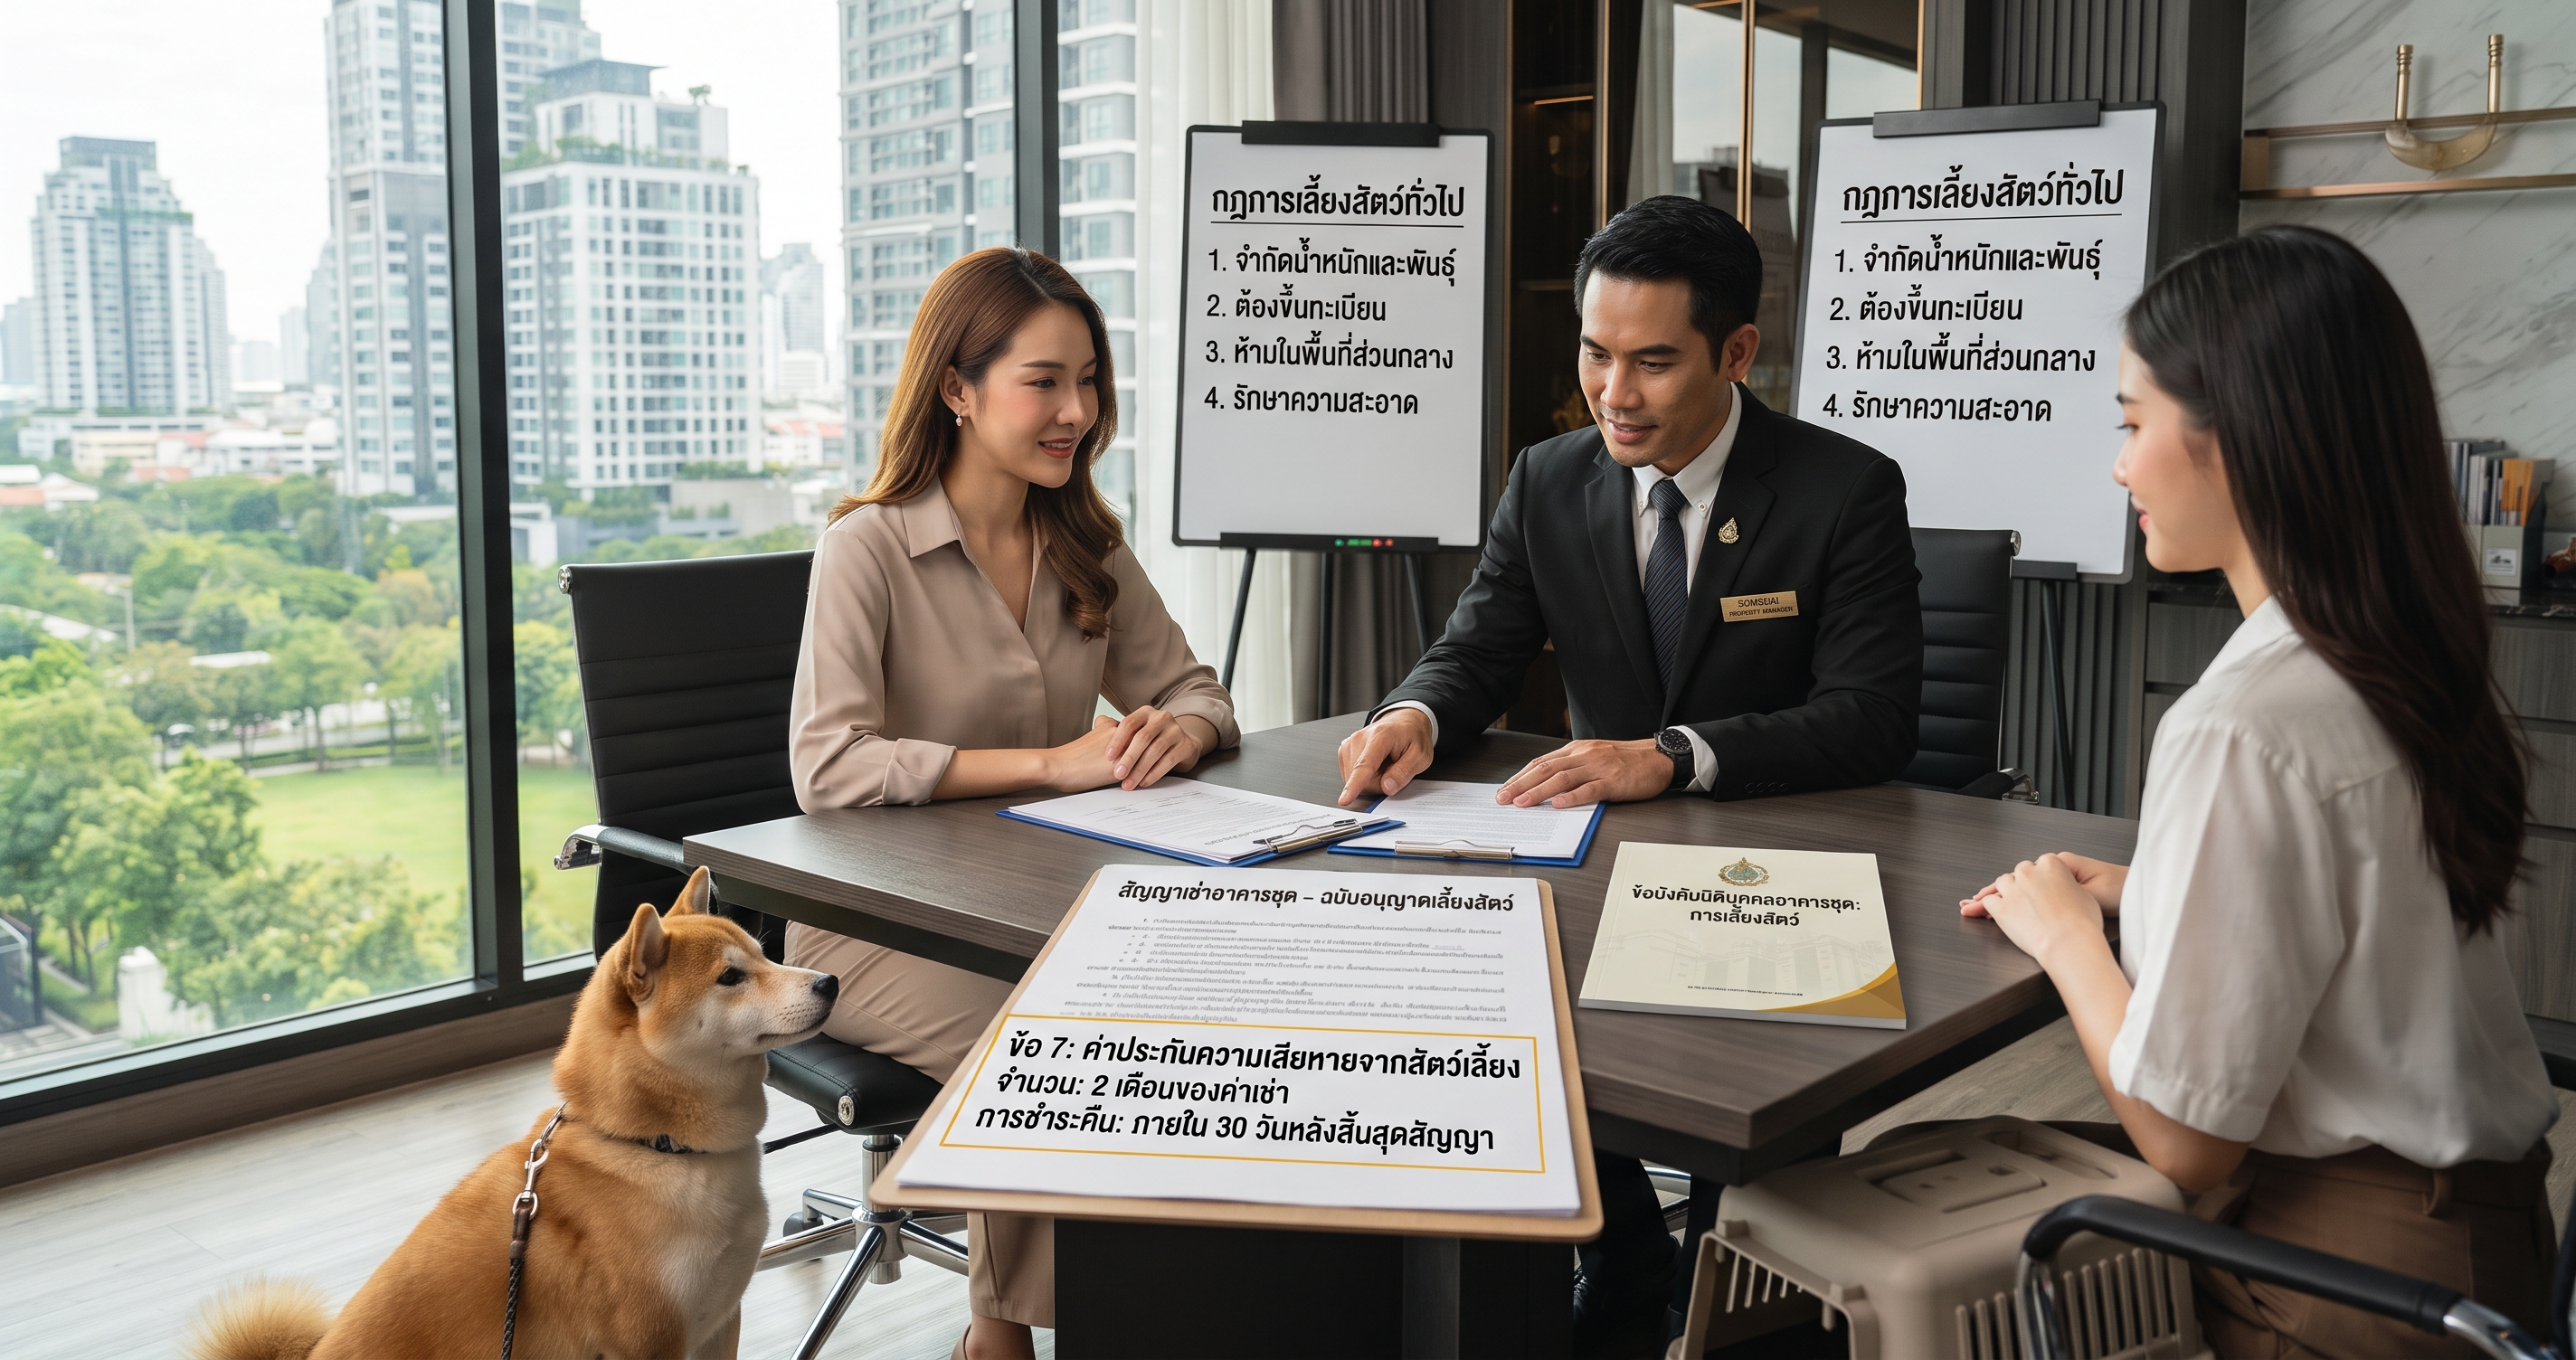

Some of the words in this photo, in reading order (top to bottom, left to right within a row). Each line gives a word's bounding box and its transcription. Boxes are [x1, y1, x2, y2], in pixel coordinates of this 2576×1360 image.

[1208, 248, 1226, 271] 1.
[1236, 237, 1457, 288] จำกัดน้ำหนักและพันธุ์
[1834, 249, 1854, 273] 1.
[1863, 233, 2104, 280] จำกัดน้ำหนักและพันธุ์
[1207, 294, 1226, 317] 2.
[1236, 283, 1386, 322] ต้องขึ้นทะเบียน
[1829, 297, 1851, 321] 2.
[1860, 283, 2023, 321] ต้องขึ้นทะเบียน
[1205, 340, 1226, 364] 3.
[1235, 330, 1454, 369] ห้ามในพื้นที่ส่วนกลาง
[1826, 345, 1847, 370] 3.
[1856, 332, 2096, 372] ห้ามในพื้นที่ส่วนกลาง
[1204, 386, 1225, 410] 4.
[1234, 383, 1418, 415] รักษาความสะอาด
[1822, 393, 1843, 418] 4.
[1852, 390, 2051, 422] รักษาความสะอาด
[1118, 880, 1298, 909] สัญญาเช่าอาคารชุด
[1009, 1030, 1043, 1058] ข้อ
[1050, 1036, 1075, 1059] 7:
[1082, 1034, 1520, 1080] ค่าประกันความเสียหายจากสัตว์เลี้ยง
[997, 1065, 1084, 1095] จำนวน:
[1091, 1074, 1109, 1097] 2
[1114, 1071, 1289, 1105] เดือนของค่าเช่า
[975, 1101, 1124, 1133] การชำระคืน:
[1131, 1109, 1208, 1138] ภายใน
[1215, 1116, 1247, 1139] 30
[1255, 1110, 1493, 1156] วันหลังสิ้นสุดสัญญา
